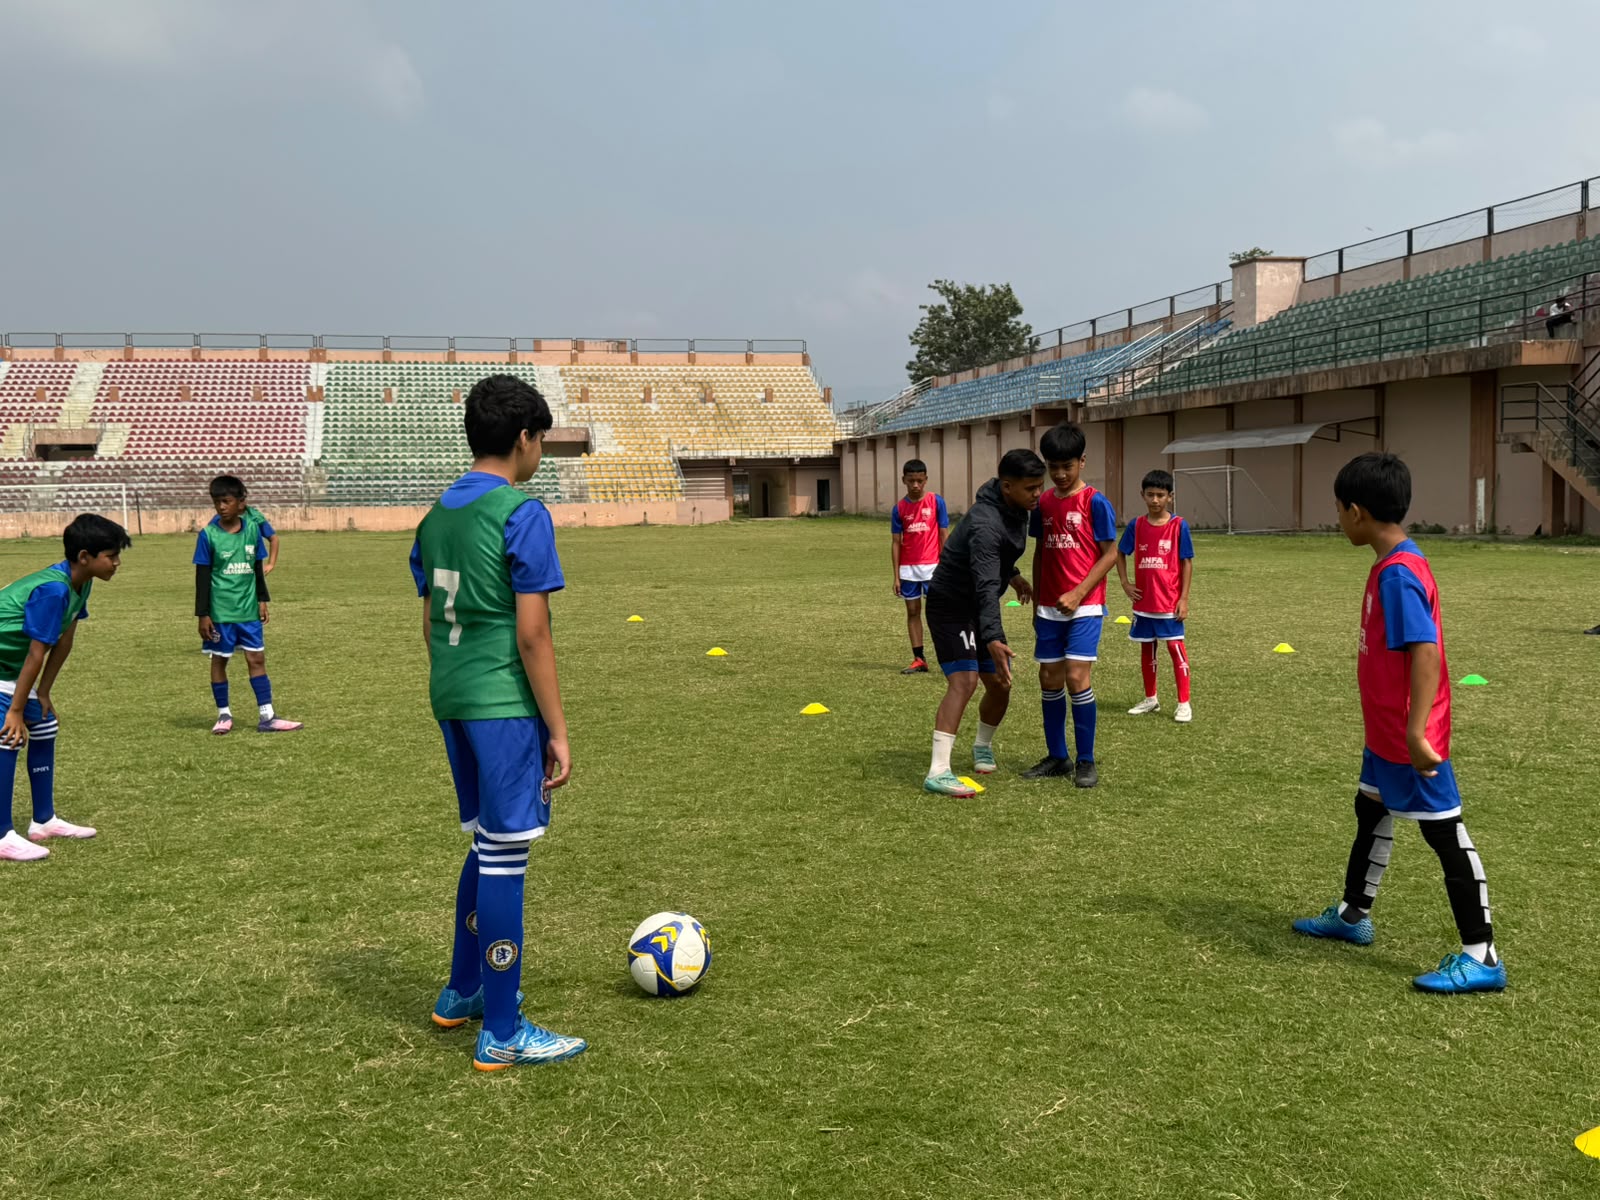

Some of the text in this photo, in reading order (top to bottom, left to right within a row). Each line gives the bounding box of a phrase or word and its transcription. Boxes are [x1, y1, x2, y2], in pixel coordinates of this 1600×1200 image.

[226, 562, 252, 570] ANFA
[1140, 556, 1164, 564] ANFA
[433, 567, 462, 646] 7
[959, 630, 977, 651] 14
